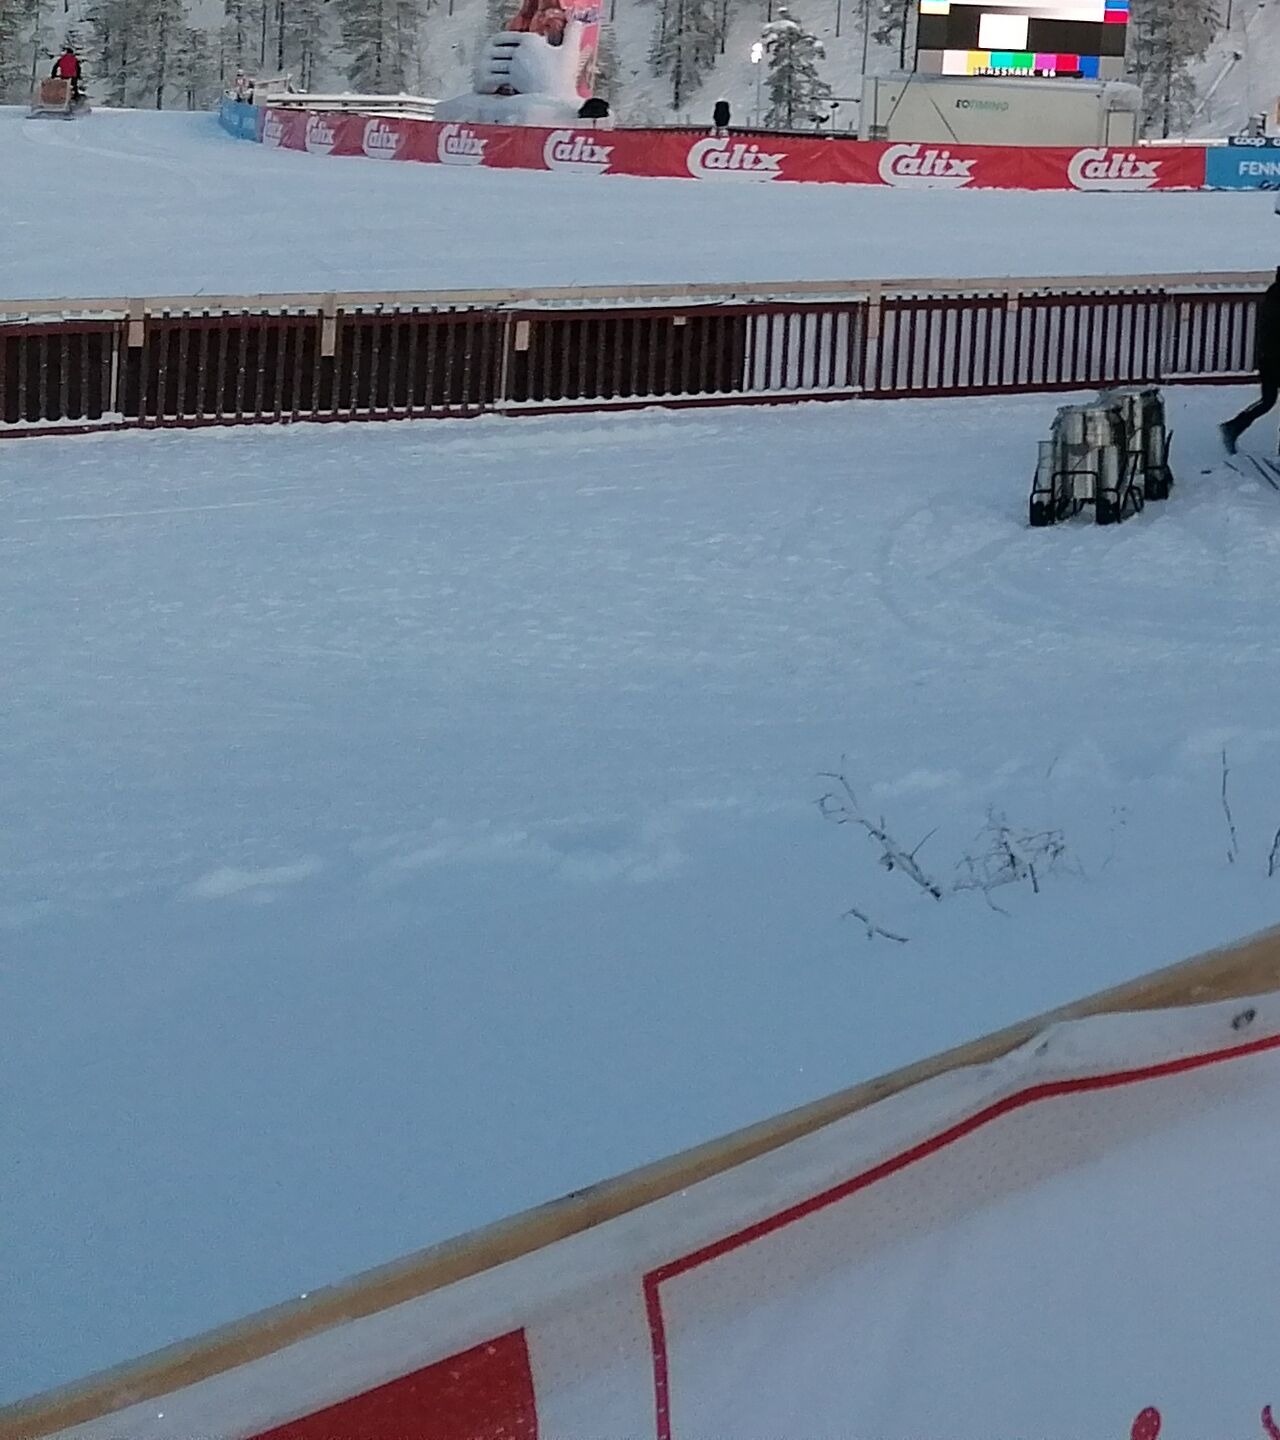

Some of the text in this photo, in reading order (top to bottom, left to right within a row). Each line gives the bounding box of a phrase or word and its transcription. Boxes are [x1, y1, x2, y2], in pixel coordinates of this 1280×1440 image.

[363, 120, 399, 159] Calix
[437, 124, 488, 166] Calix
[543, 129, 614, 175] Calix
[687, 137, 788, 182] Calix
[1233, 137, 1266, 148] coop
[878, 144, 978, 188] Calix
[1067, 148, 1162, 190] Calix
